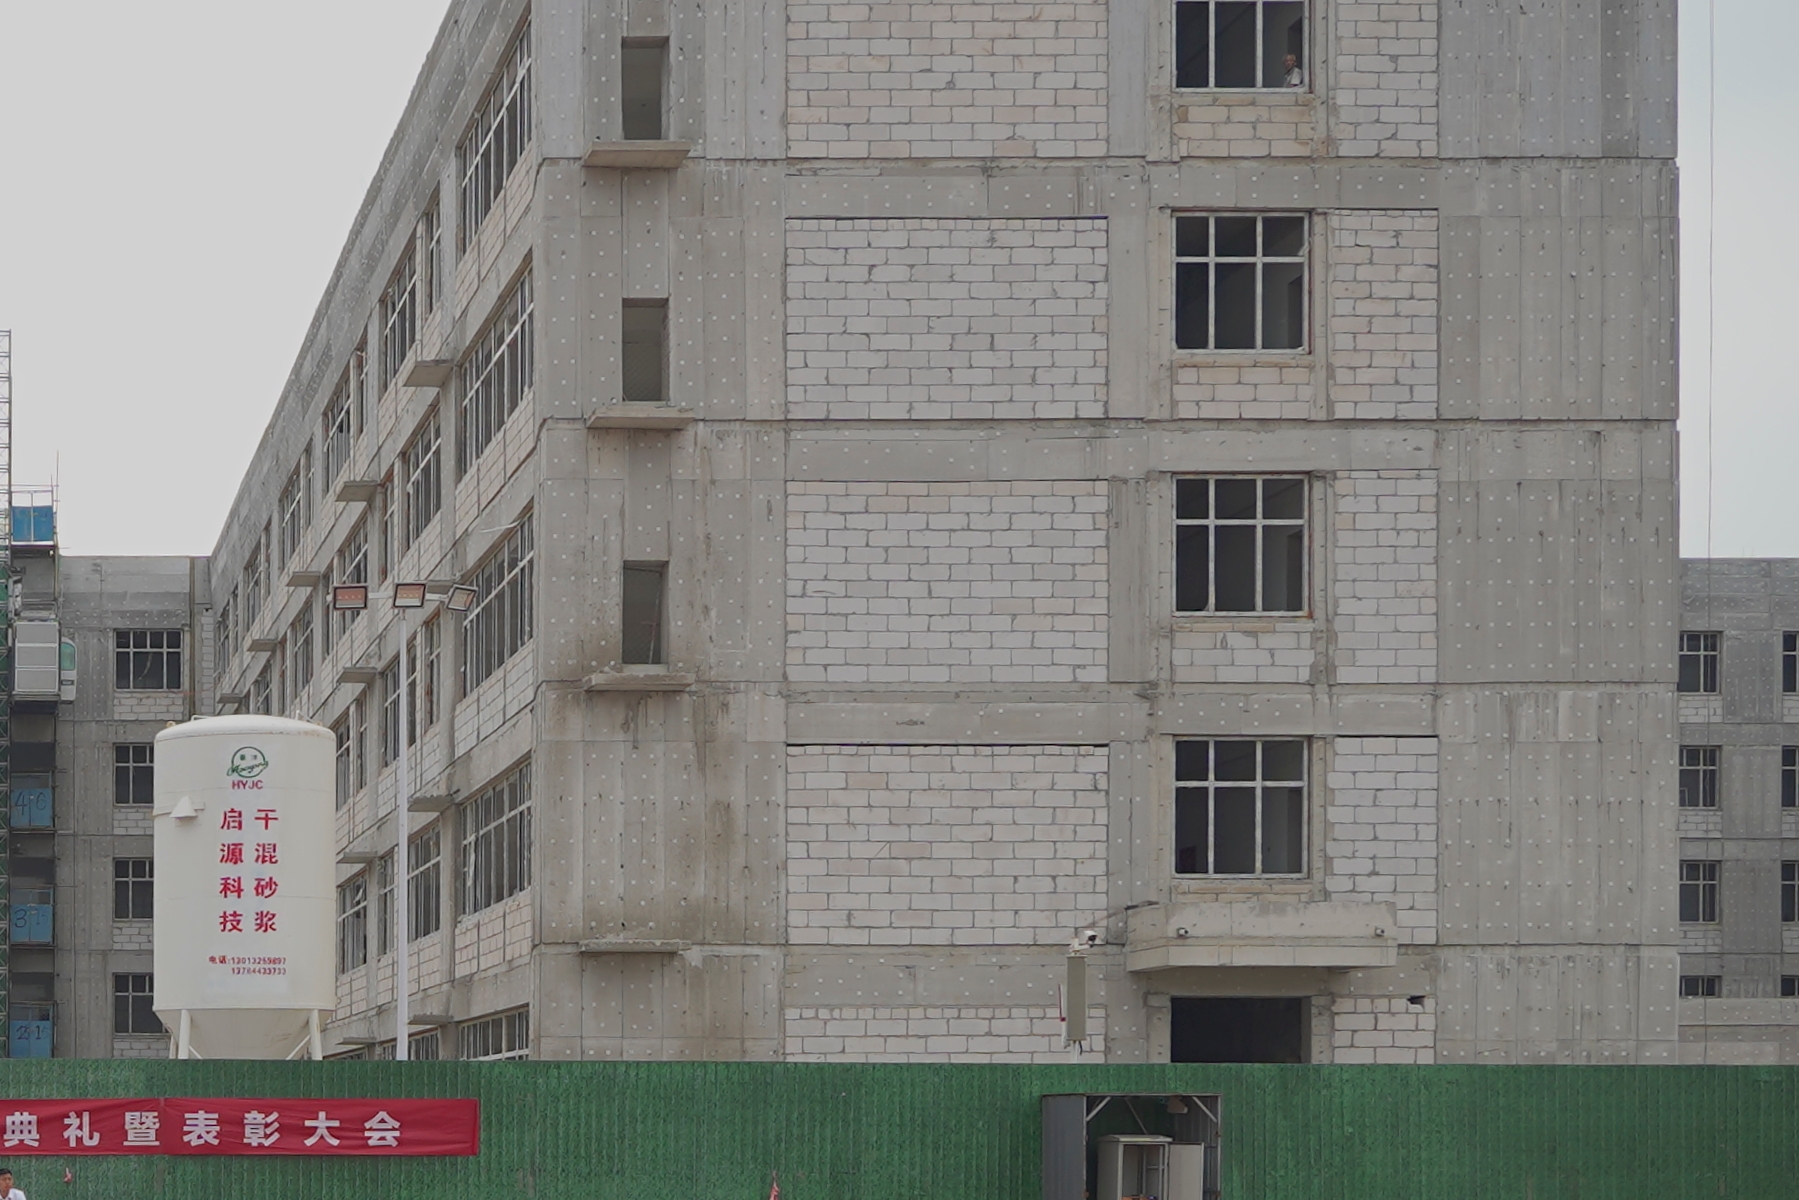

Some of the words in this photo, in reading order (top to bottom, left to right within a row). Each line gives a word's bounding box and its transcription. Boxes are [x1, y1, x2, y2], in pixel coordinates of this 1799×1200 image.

[231, 779, 264, 790] HYJC
[218, 807, 245, 933] 启源科技
[253, 808, 279, 933] 干混砂浆
